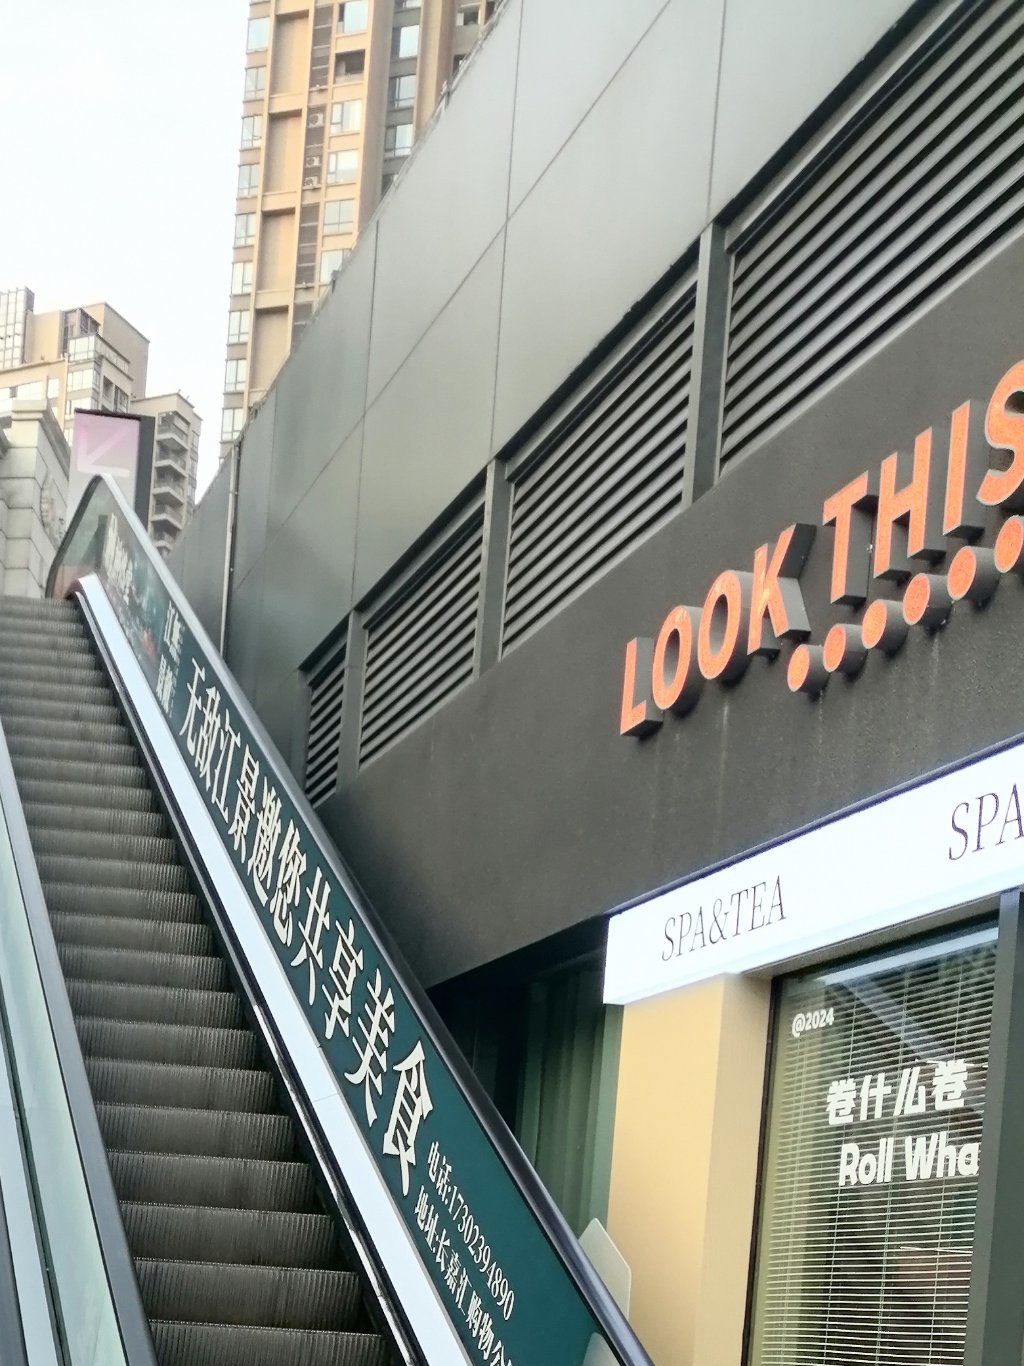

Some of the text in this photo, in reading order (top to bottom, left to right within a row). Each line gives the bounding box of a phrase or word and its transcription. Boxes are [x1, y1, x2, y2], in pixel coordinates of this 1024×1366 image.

[620, 360, 1024, 736] LOOK THIS
[661, 875, 787, 962] SPA&TEA
[791, 1007, 835, 1039] @2024
[838, 1137, 894, 1187] Roll
